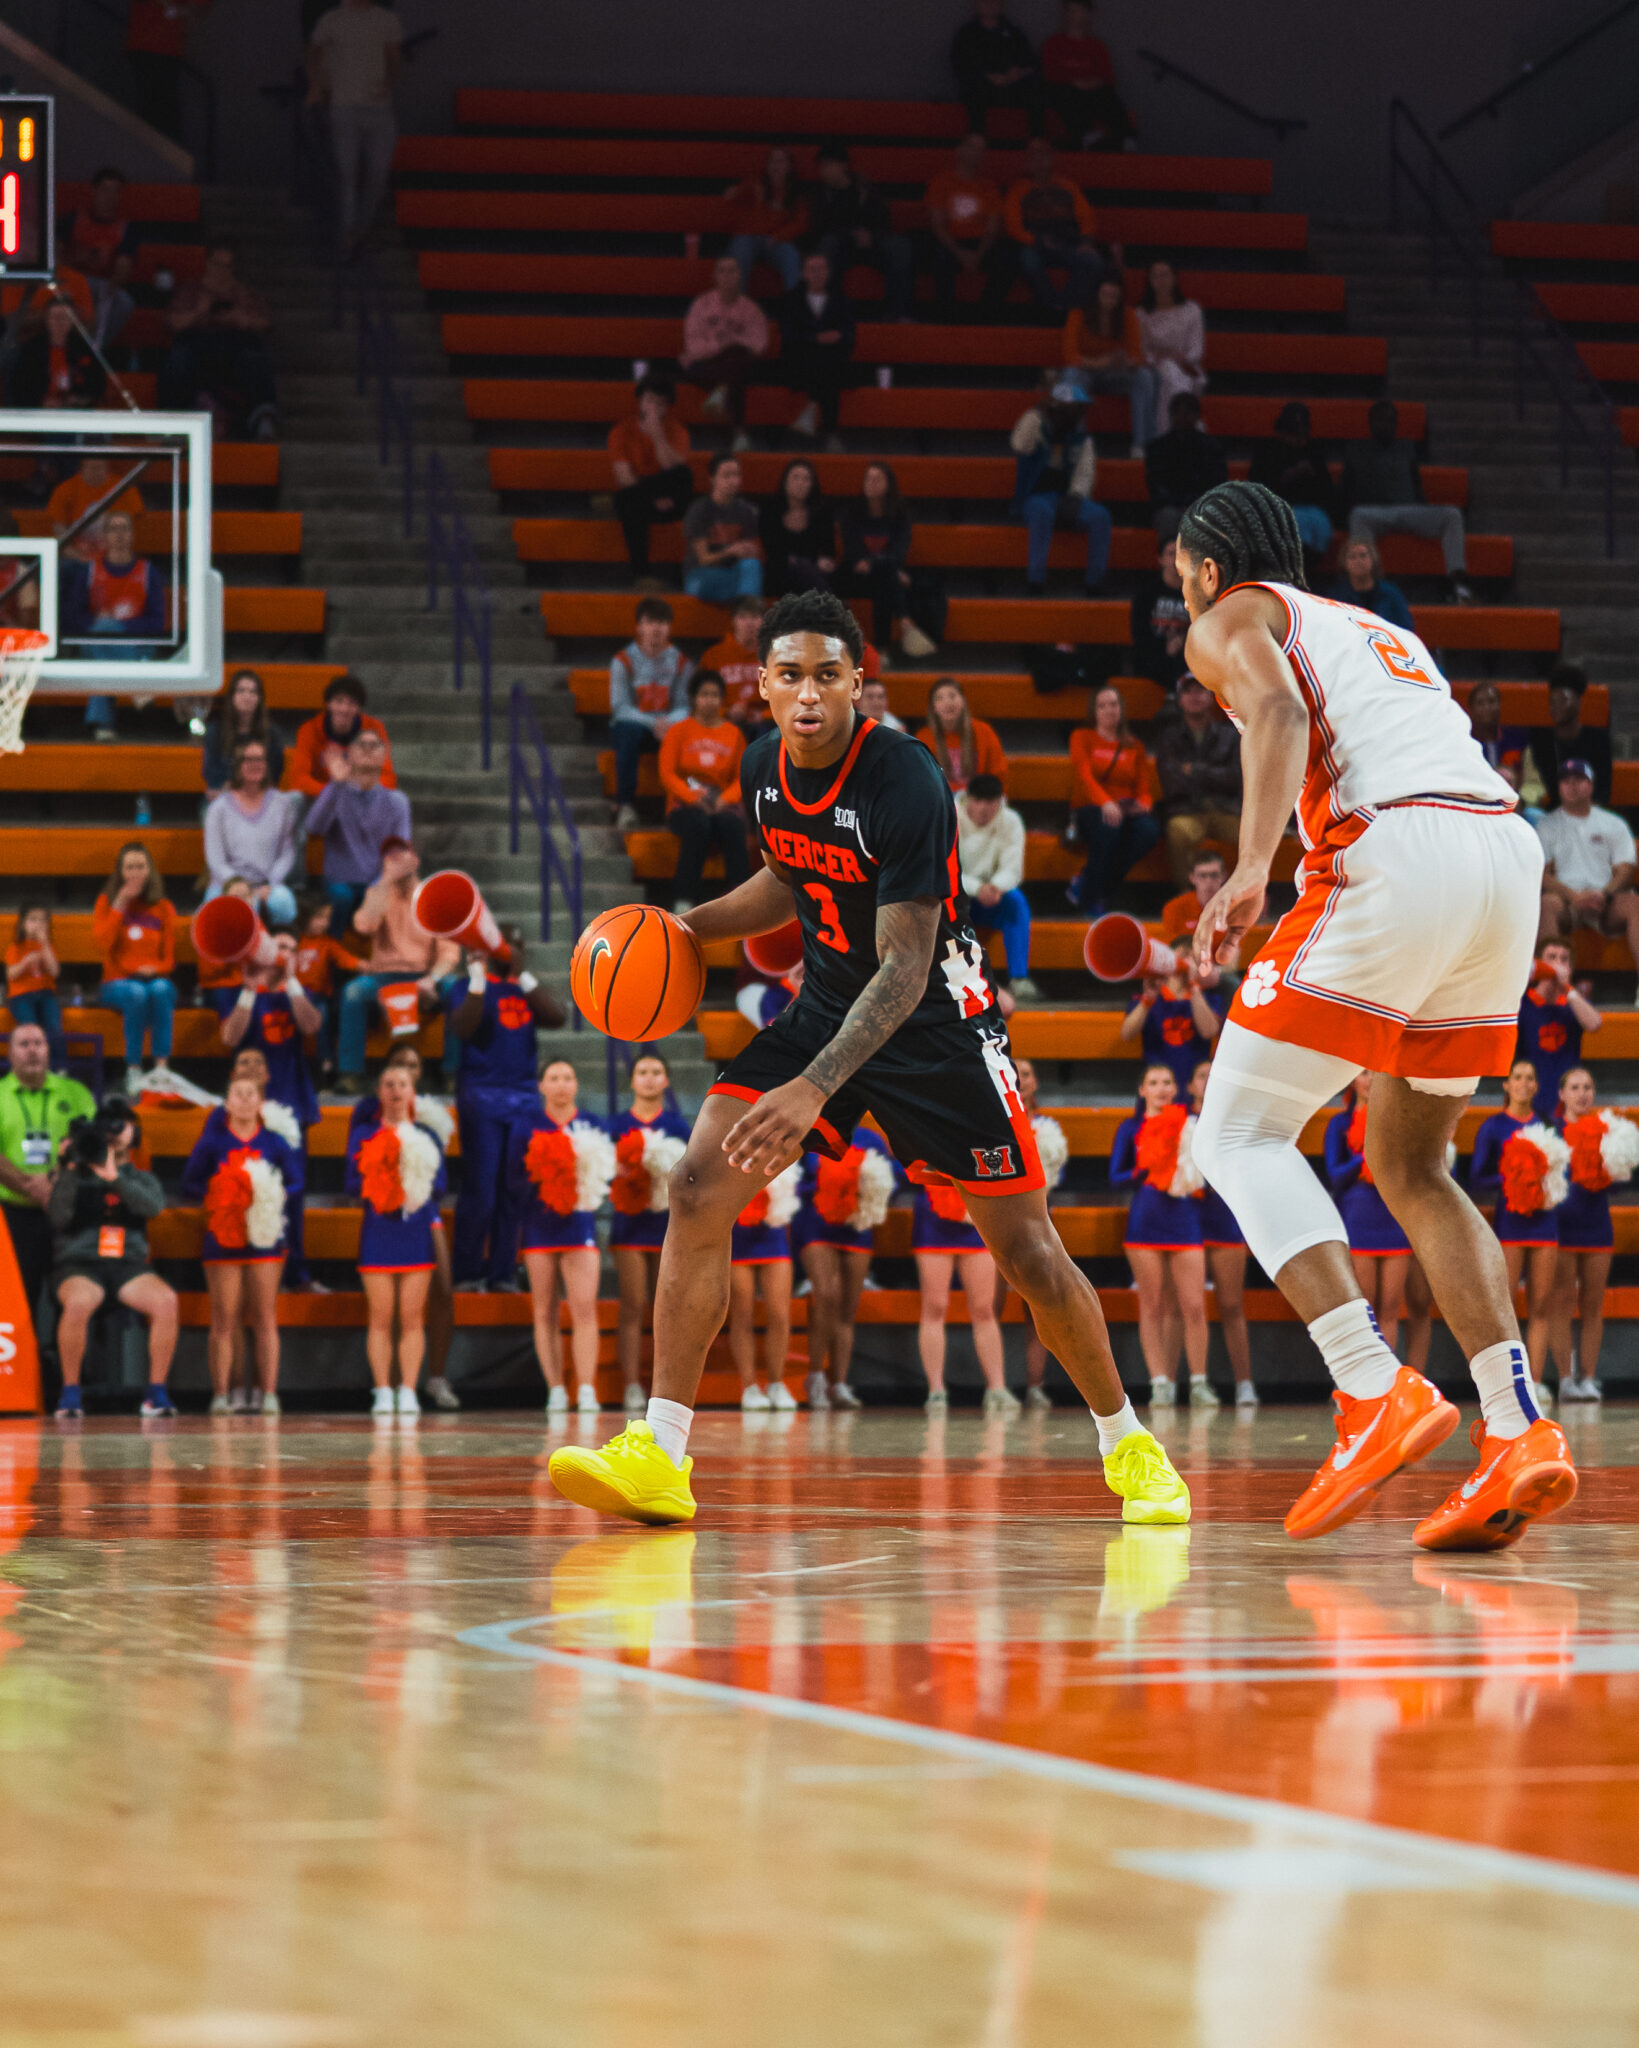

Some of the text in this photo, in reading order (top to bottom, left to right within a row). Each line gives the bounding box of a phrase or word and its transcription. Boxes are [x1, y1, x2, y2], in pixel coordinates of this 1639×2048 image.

[1348, 617, 1441, 691] 2
[761, 824, 869, 883] MERCER
[802, 882, 850, 954] 3
